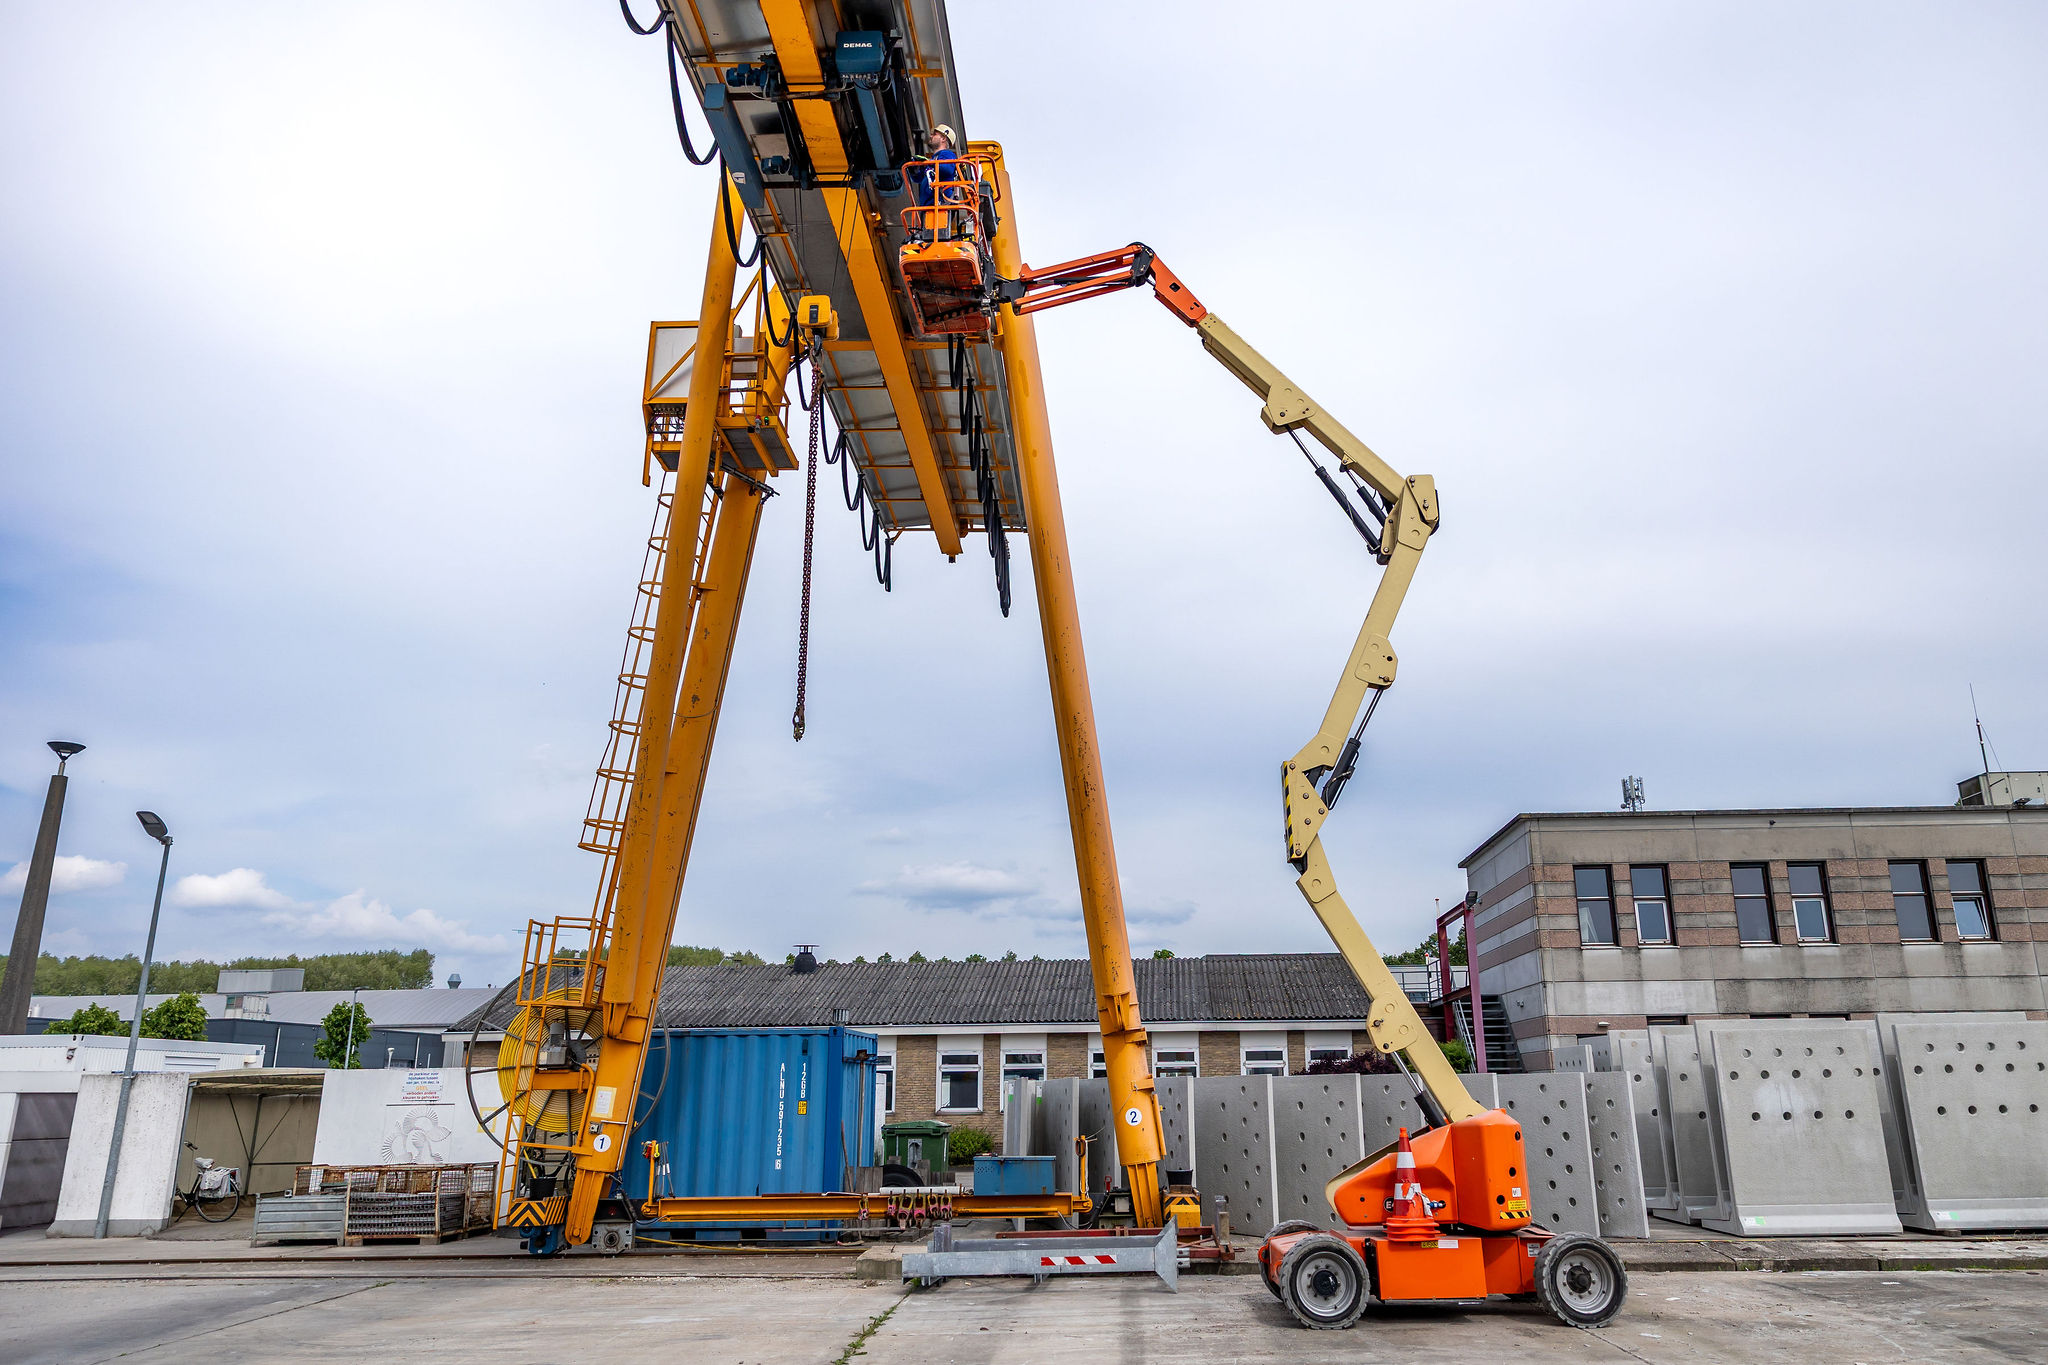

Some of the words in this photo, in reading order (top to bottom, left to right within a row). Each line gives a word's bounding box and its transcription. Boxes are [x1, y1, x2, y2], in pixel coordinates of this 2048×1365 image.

[1129, 1110, 1138, 1124] 2
[776, 1101, 785, 1156] 591235
[599, 1137, 605, 1150] 1
